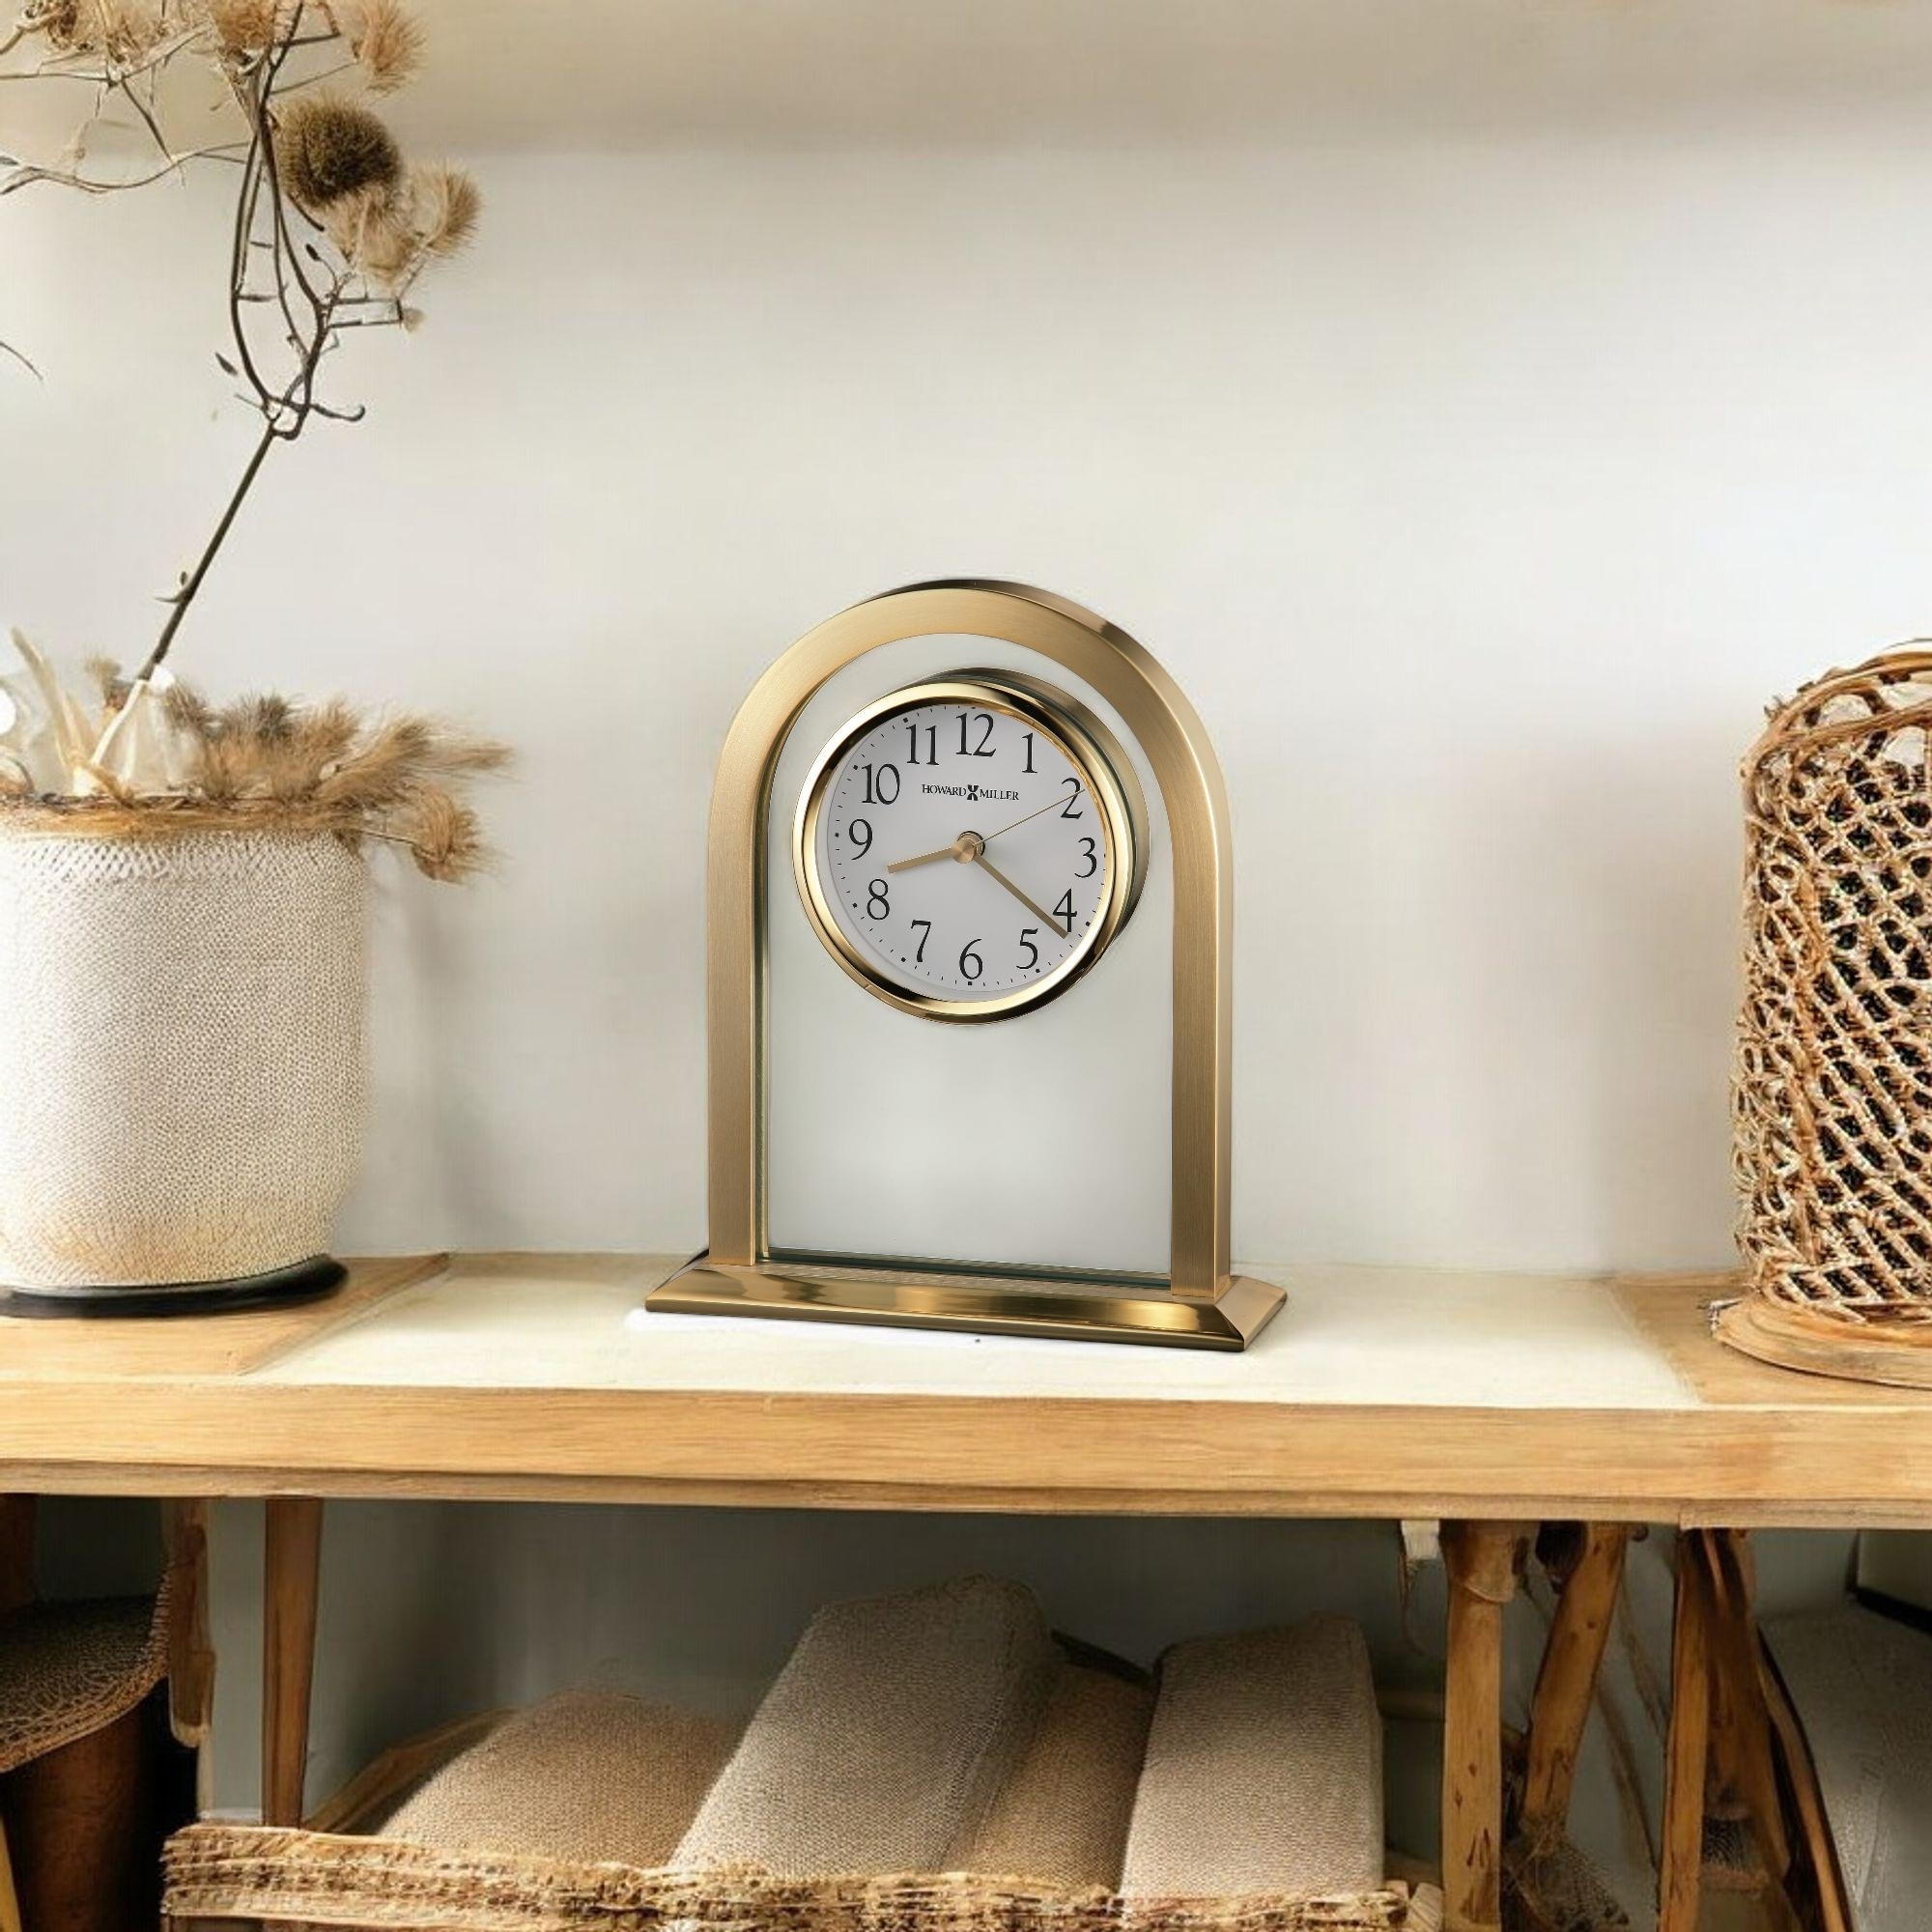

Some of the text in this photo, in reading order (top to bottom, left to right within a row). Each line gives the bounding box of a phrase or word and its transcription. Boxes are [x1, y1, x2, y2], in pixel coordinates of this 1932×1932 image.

[905, 724, 940, 766] 11
[956, 713, 997, 757] 12
[1021, 732, 1038, 774] 1
[861, 763, 900, 806] 10
[922, 783, 1020, 801] HOWARD MILLER
[1060, 777, 1085, 820] 2
[848, 818, 873, 861] 9
[1073, 837, 1097, 878] 3
[866, 878, 891, 921] 8
[1052, 888, 1078, 933] 4
[910, 919, 932, 963] 7
[958, 938, 983, 980] 6
[1015, 927, 1039, 970] 5
